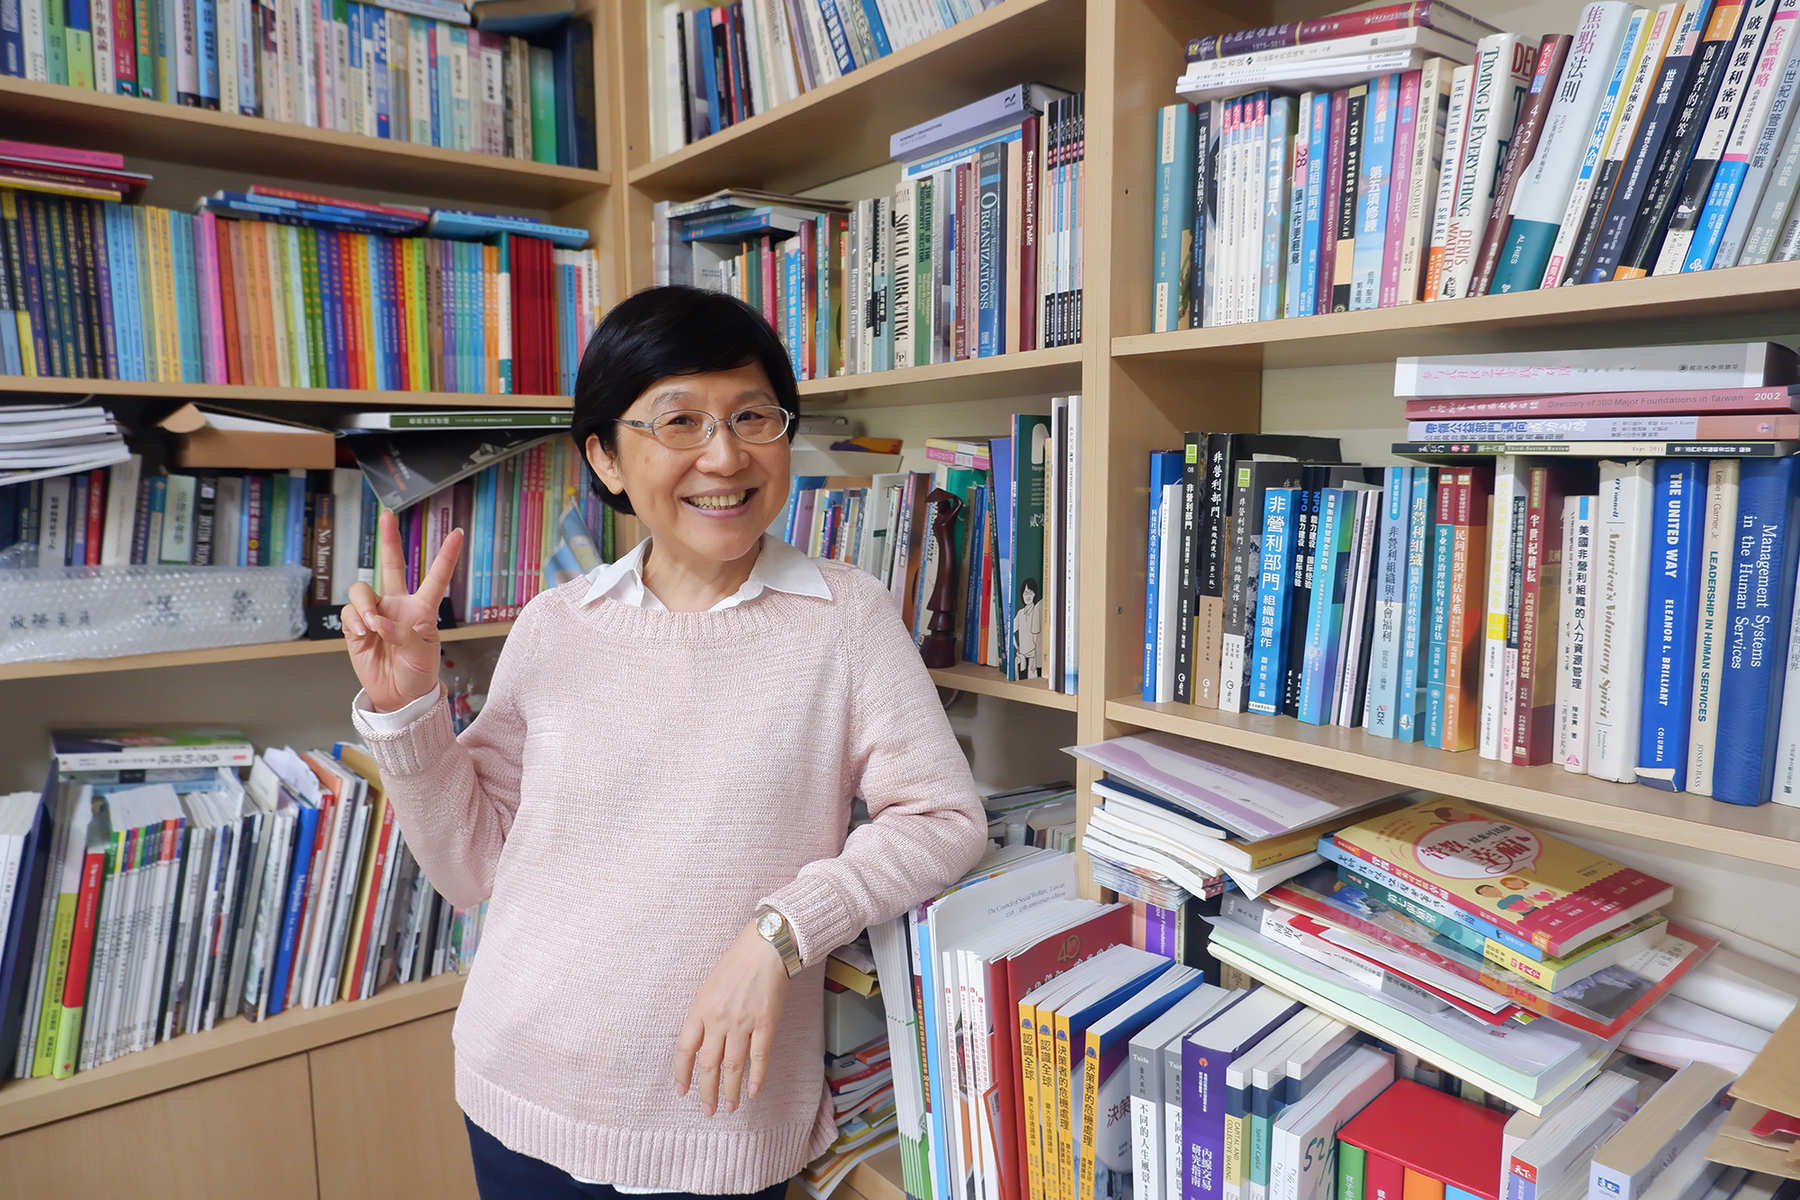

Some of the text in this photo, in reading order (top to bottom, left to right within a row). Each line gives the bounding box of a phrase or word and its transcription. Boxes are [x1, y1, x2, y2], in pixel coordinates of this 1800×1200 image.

[1558, 6, 1604, 104] 焦點法則
[1714, 16, 1762, 120] 破解獲利密碼
[1754, 26, 1786, 88] 全贏戰略
[1656, 68, 1677, 104] 世界級
[1676, 46, 1716, 138] 創新者的解答
[1458, 46, 1500, 218] TIMING IS EVERYTHING
[1585, 95, 1615, 166] 點石成金
[1342, 120, 1358, 238] TOM PETERS SEMINAR
[1434, 78, 1466, 240] THE MYTH OF MARKET SHARE
[924, 235, 930, 245] OF
[980, 192, 997, 310] ORGANIZATIONS
[1442, 222, 1460, 272] WAITLEY
[1454, 230, 1472, 266] DENIS
[1510, 234, 1525, 264] AL RIES
[894, 214, 910, 341] SOCIAL MARKETING
[1426, 255, 1436, 290] MINITER
[1432, 254, 1442, 290] RICHARD
[1548, 400, 1584, 408] Directory
[1614, 398, 1638, 407] Major
[1640, 396, 1697, 404] Foundations
[1754, 392, 1780, 400] 2002
[1301, 491, 1309, 512] NPO
[1312, 491, 1320, 513] NPO
[1612, 477, 1621, 518] O'Connell
[1715, 471, 1723, 492] Leslie
[318, 529, 332, 543] No
[1664, 472, 1682, 578] THE UNITED WAY
[317, 546, 330, 573] Man's
[1260, 496, 1286, 648] 非營利部門 組織與運作
[1405, 497, 1426, 658] 非營利組織 協調合作的社會福利服務
[1452, 530, 1466, 614] 民间组织评估体系
[1382, 526, 1399, 643] 非營利組織與社會福利
[1571, 525, 1589, 690] 美國非營利組織的人力資源管理
[1731, 516, 1757, 669] in the Human Services
[1751, 524, 1777, 667] Management Systems
[474, 612, 480, 622] 1
[483, 610, 490, 620] 2
[491, 608, 498, 618] 3
[499, 608, 506, 618] 4
[508, 608, 514, 617] 5
[1599, 530, 1620, 719] America's Voluntary Spirit
[1663, 599, 1674, 643] ELEANOR
[1697, 550, 1718, 722] LEADERSHIP IN HUMAN SERVICES
[1658, 657, 1670, 706] BRILLIANT
[1655, 727, 1665, 762] COLUMBIA
[1420, 836, 1532, 873] 管教 幸福
[987, 907, 996, 915] The
[996, 900, 1014, 911] Council
[1018, 894, 1031, 905] Social
[1049, 883, 1066, 893] Taiwan
[1022, 1032, 1035, 1081] 認識全球
[1040, 1039, 1052, 1088] 認識全球
[1132, 1054, 1149, 1064] Taida
[1058, 1044, 1070, 1132] 決策者的危機處理
[1083, 1061, 1096, 1148] 決策者的危機處理
[1140, 1103, 1150, 1184] 不同的人生風景
[1191, 1143, 1200, 1188] 研究指南
[1254, 1151, 1263, 1171] Capital
[1202, 1148, 1212, 1191] 內線交易
[1514, 1165, 1531, 1178] 天下
